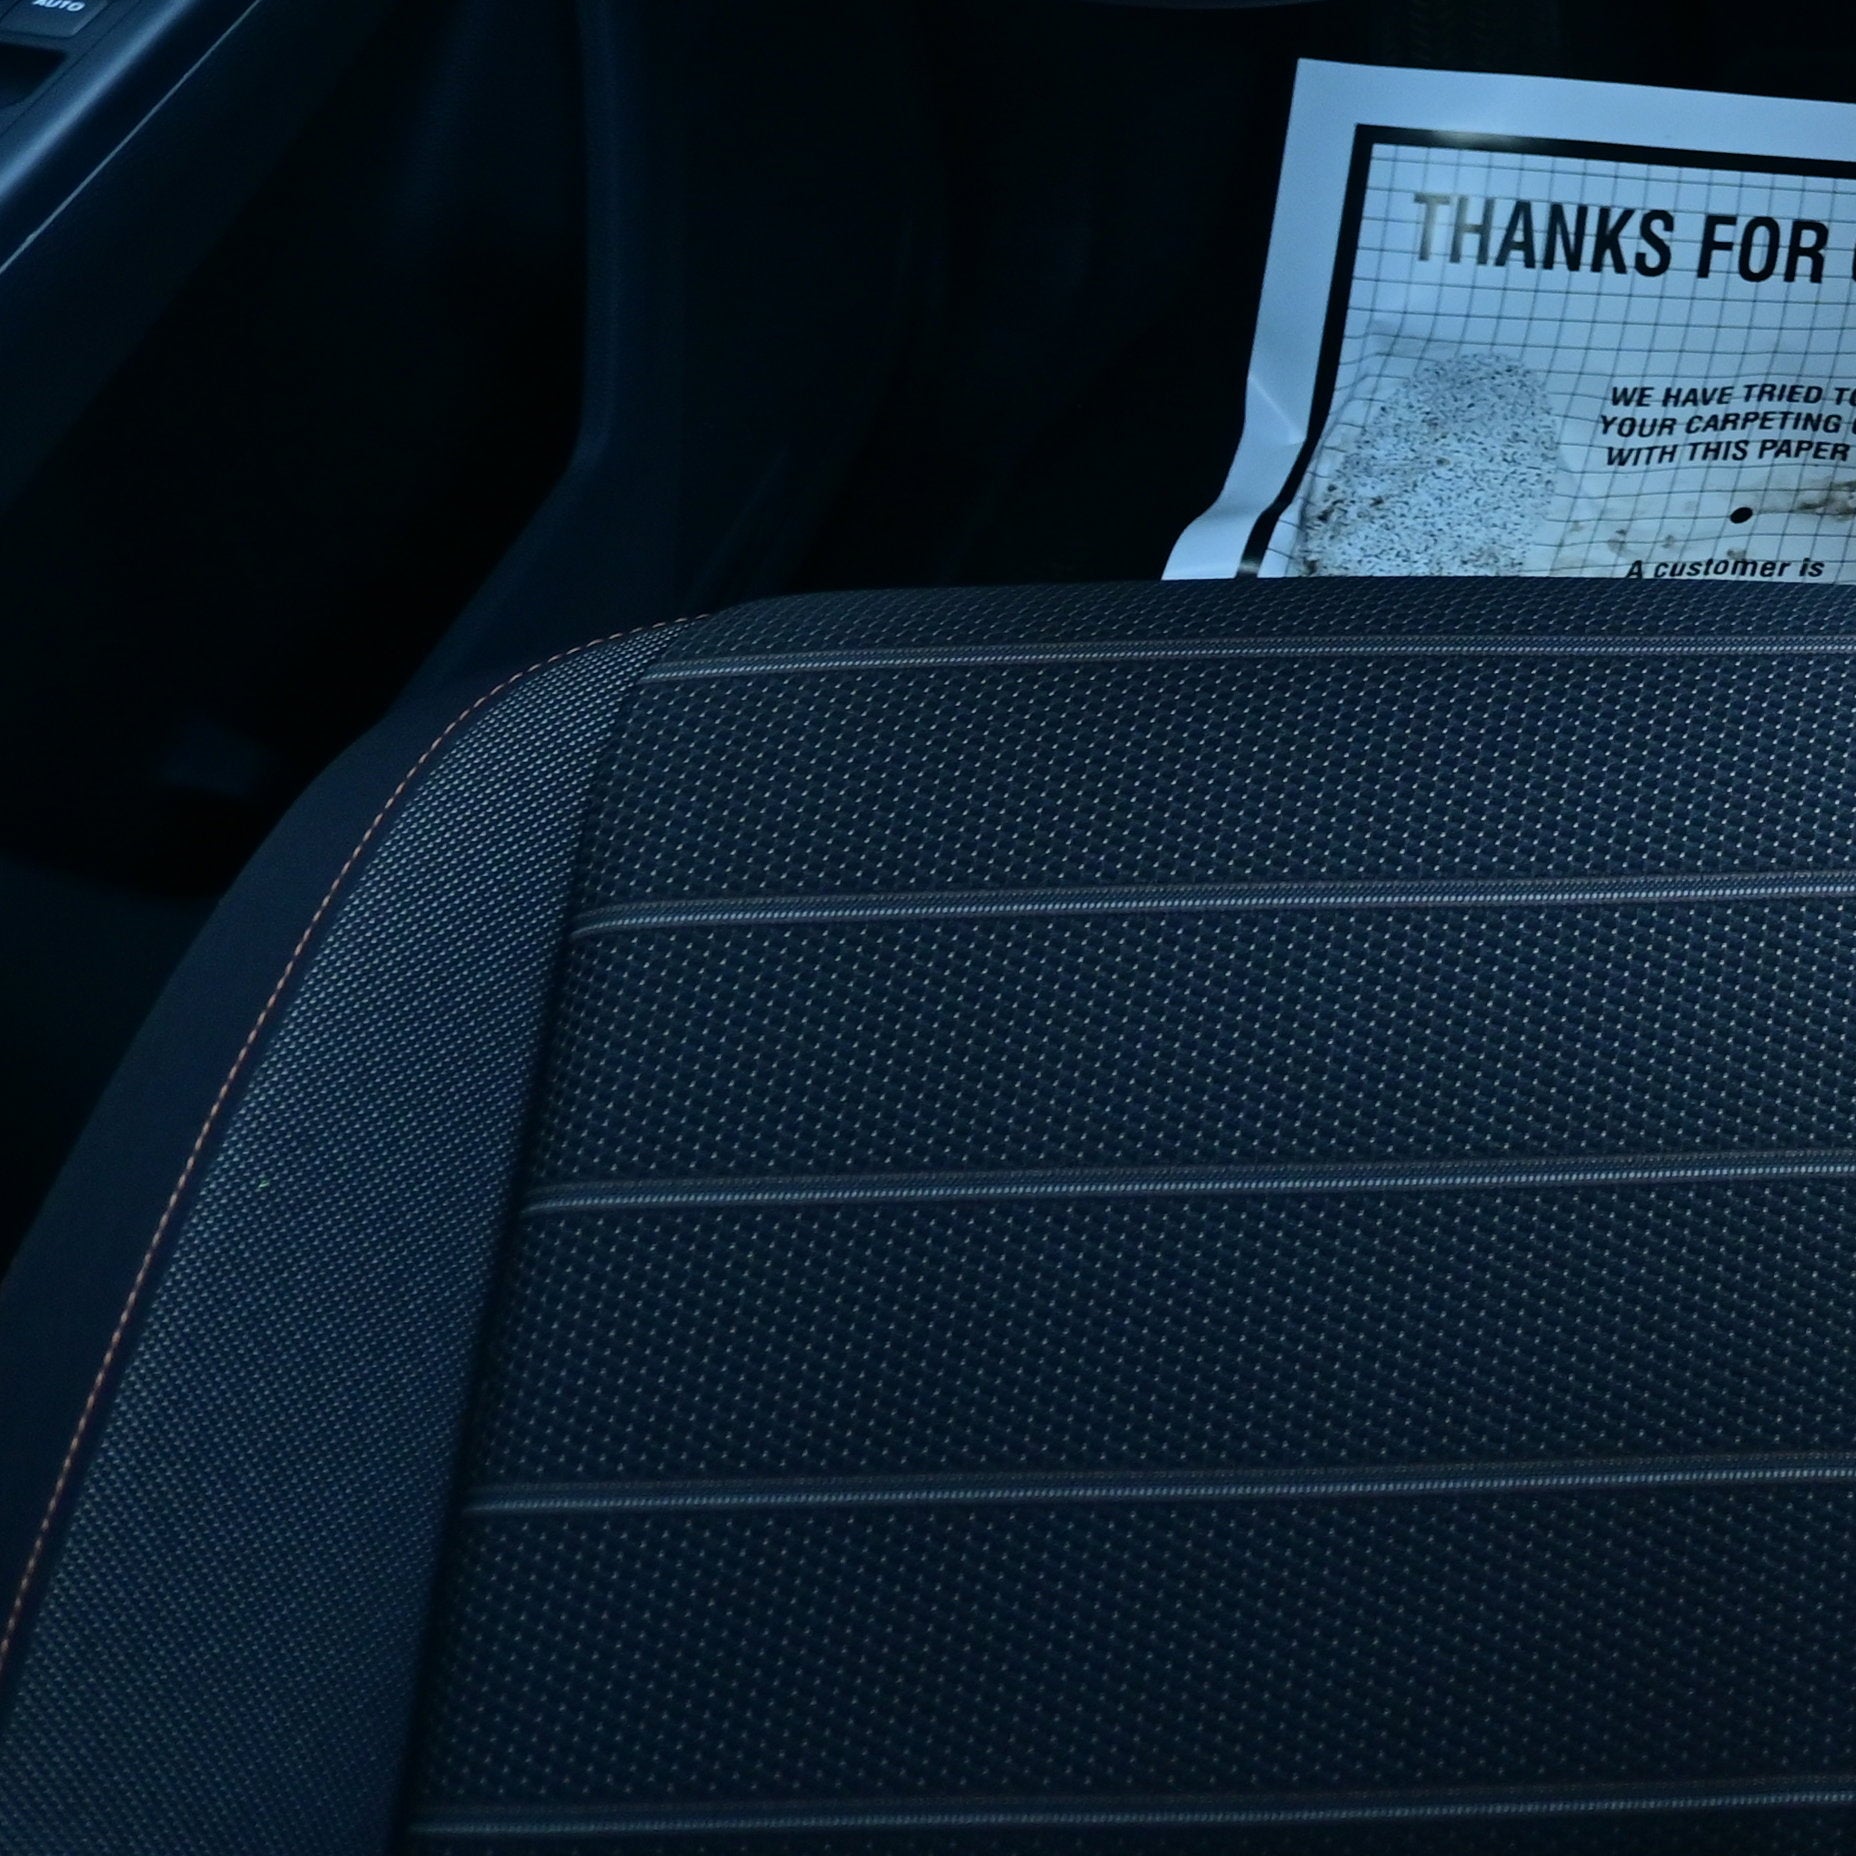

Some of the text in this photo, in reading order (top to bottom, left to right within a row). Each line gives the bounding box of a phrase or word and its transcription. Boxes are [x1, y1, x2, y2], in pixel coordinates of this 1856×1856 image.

[1413, 193, 1674, 277] THANKS
[1696, 213, 1830, 284] FOR
[1611, 387, 1654, 407] WE
[1661, 386, 1735, 407] HAVE
[1742, 384, 1823, 404] TRIED
[1600, 415, 1677, 437] YOUR
[1685, 411, 1842, 435] CARPETING
[1606, 447, 1677, 467] WITH
[1689, 440, 1749, 462] THIS
[1758, 439, 1850, 463] PAPER
[1626, 558, 1825, 579] A customer is
